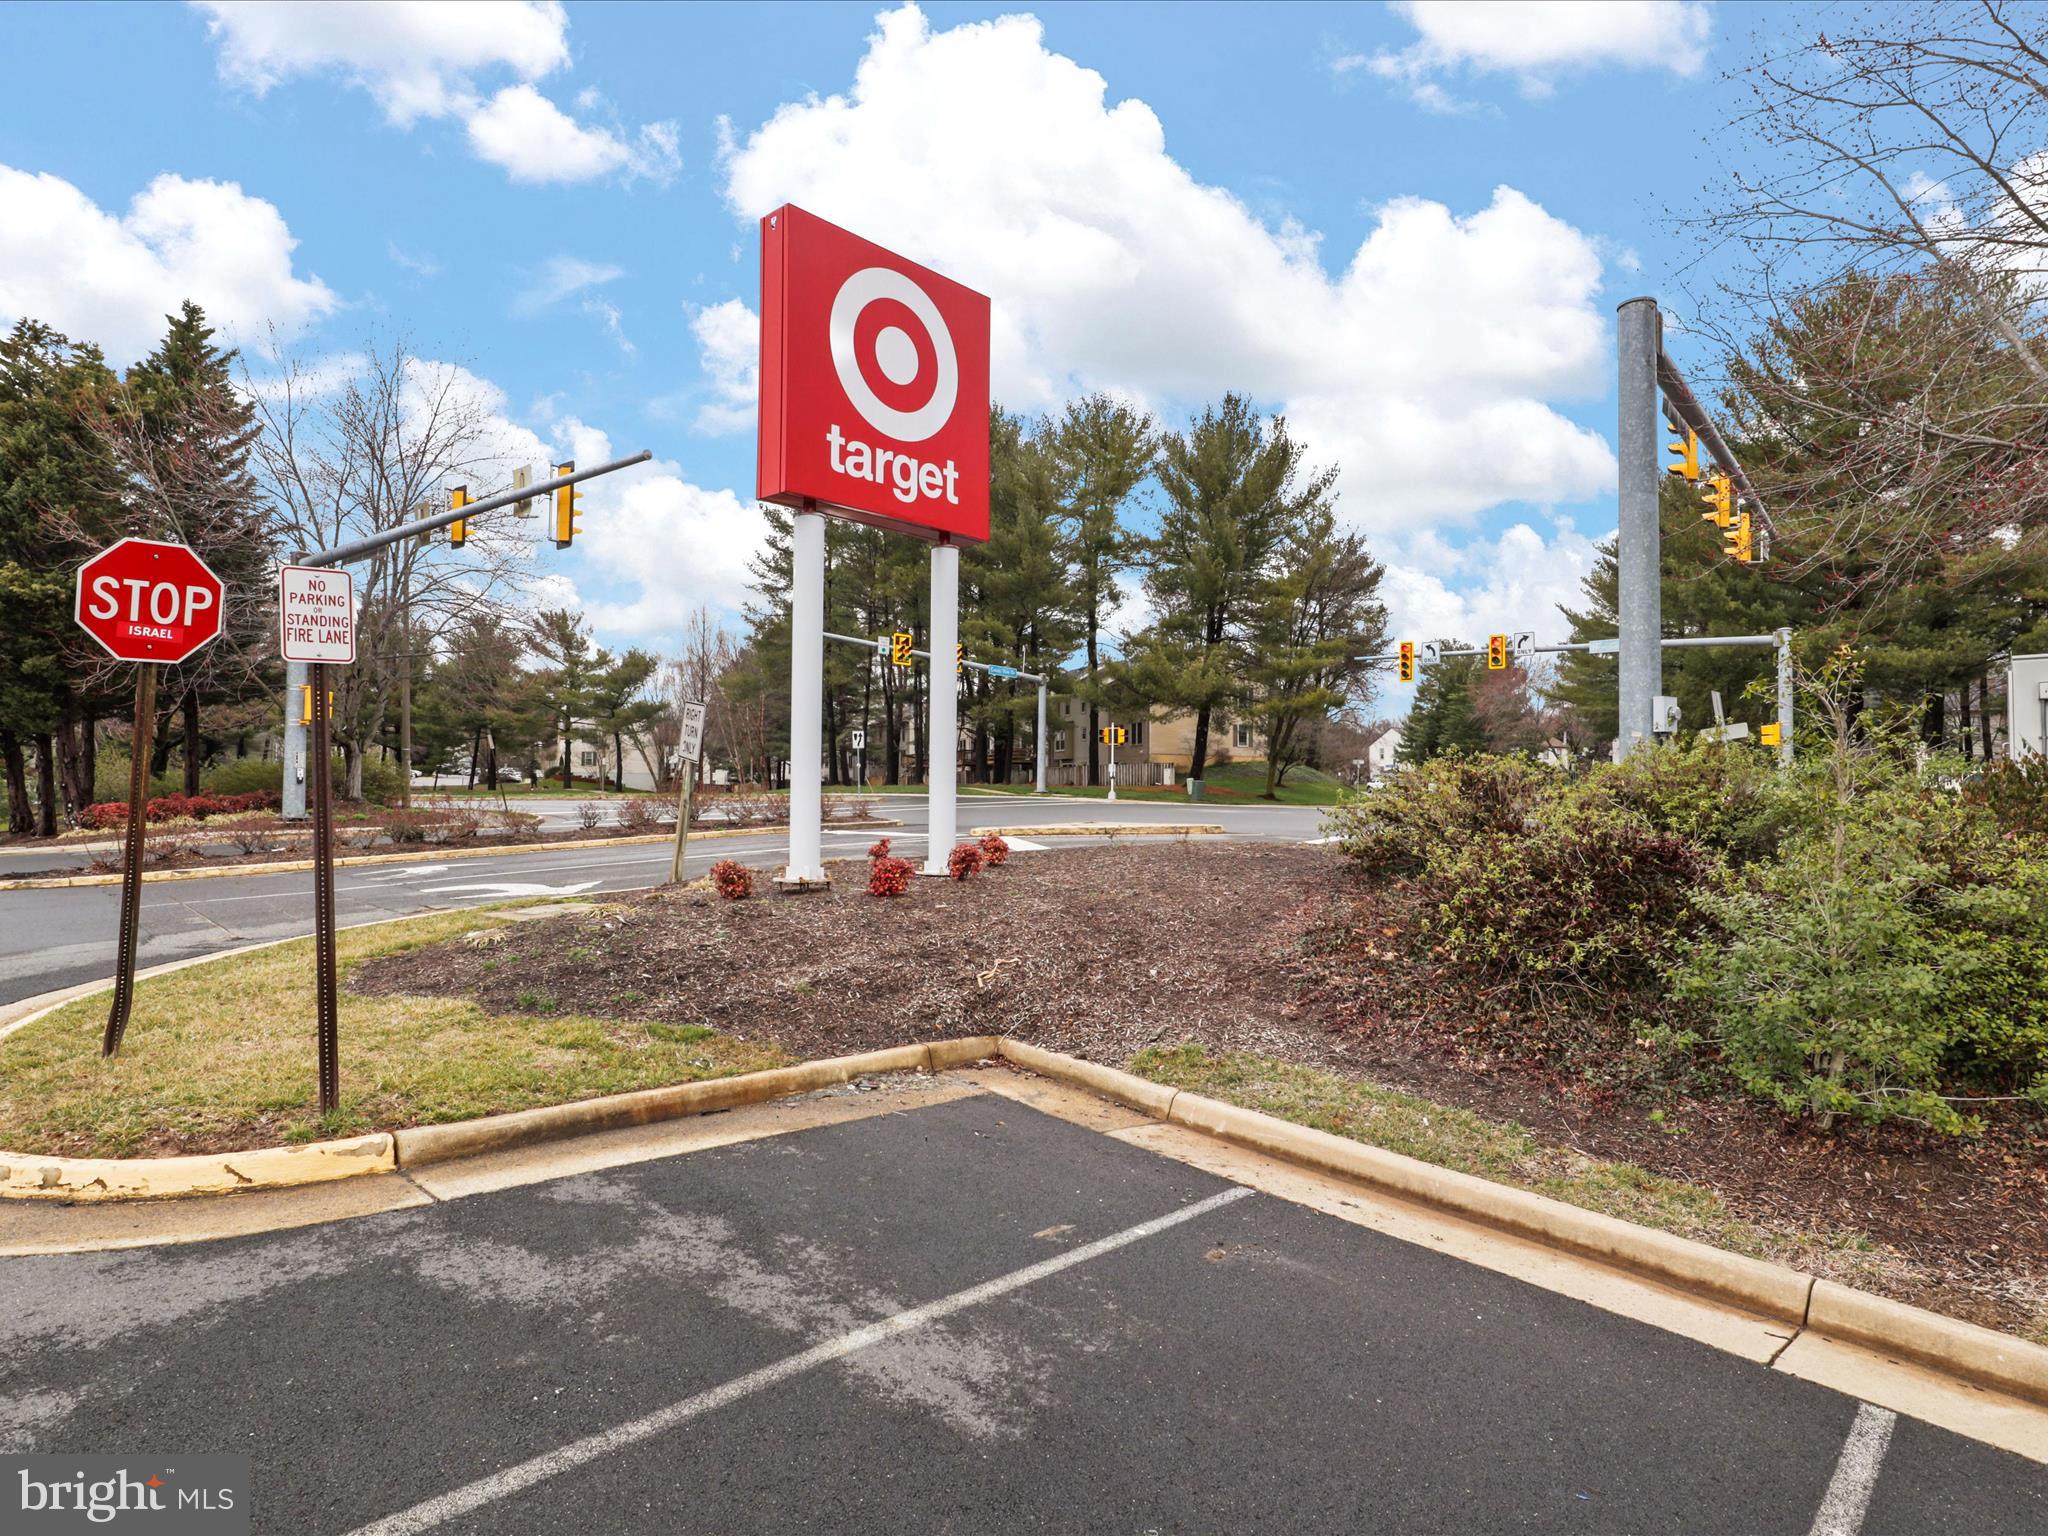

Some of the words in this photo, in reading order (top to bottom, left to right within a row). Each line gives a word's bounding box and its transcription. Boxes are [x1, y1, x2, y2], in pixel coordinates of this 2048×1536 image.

[826, 423, 959, 505] target
[308, 579, 326, 592] NO
[88, 575, 213, 626] STOP
[289, 591, 345, 608] PARKING
[287, 613, 349, 628] STANDING
[128, 625, 173, 640] ISRAEL
[287, 627, 314, 643] FIRE
[318, 629, 350, 645] LANE
[685, 707, 702, 722] RIGHT
[684, 723, 699, 739] TURN
[682, 740, 697, 755] ONLY
